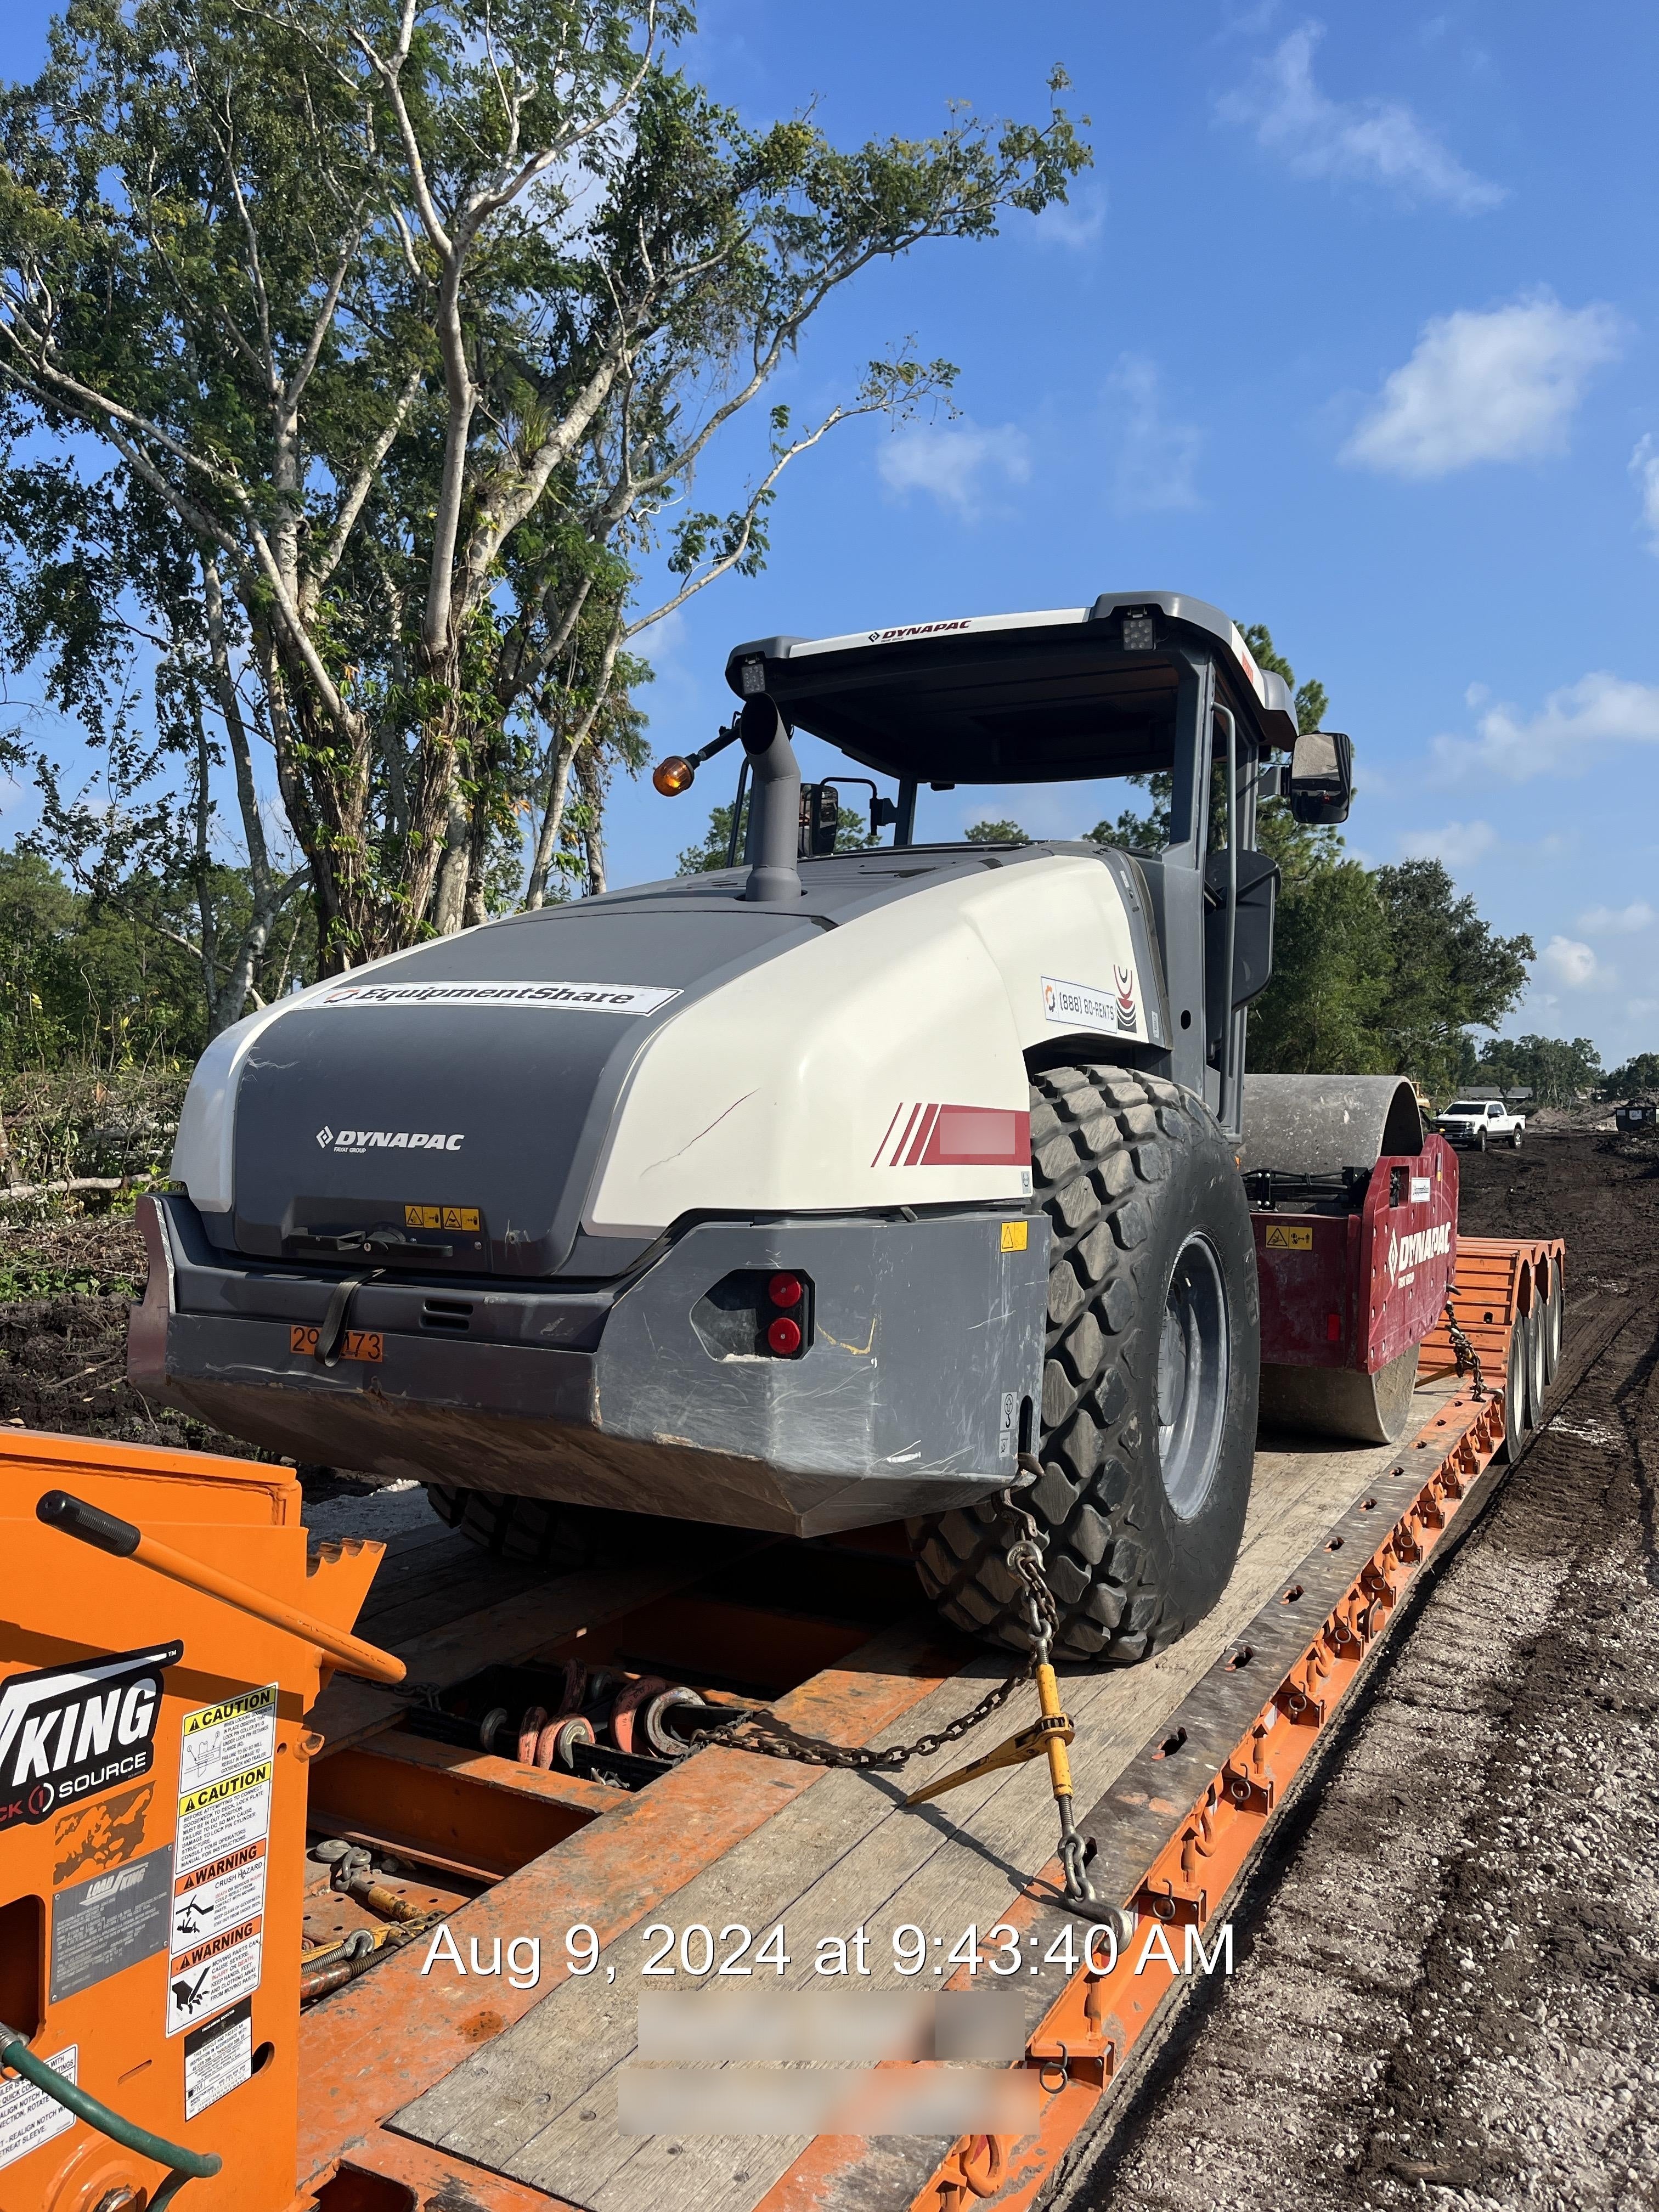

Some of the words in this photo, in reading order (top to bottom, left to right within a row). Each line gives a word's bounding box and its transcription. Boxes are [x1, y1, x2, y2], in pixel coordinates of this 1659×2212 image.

[882, 620, 972, 639] DYNAPAC
[357, 987, 635, 1004] EquipmentShare
[1059, 991, 1082, 1014] (888)
[1084, 998, 1114, 1020] 80-RENTS
[335, 1131, 465, 1150] DYNAPAC
[1398, 1221, 1451, 1272] DYNAPAC
[202, 1689, 270, 1726] CAUTION
[235, 1714, 250, 1723] LOCKING
[251, 1706, 272, 1717] GOOSENECK
[12, 1678, 156, 1787] KING
[228, 1724, 239, 1732] PLACE
[222, 1743, 236, 1753] FLANGE
[222, 1752, 236, 1760] FAILURE
[59, 1752, 146, 1798] SOURCE
[221, 1760, 243, 1773] GOOSENECK
[222, 1758, 235, 1767] RESULT
[198, 1766, 266, 1806] CAUTION
[183, 1810, 202, 1822] BEFORE
[204, 1797, 233, 1814] ATTEMPTING
[240, 1785, 262, 1798] CONNECT
[183, 1812, 213, 1829] GOOSENECK
[236, 1797, 248, 1805] LOCK
[250, 1790, 263, 1800] PLATE
[182, 1830, 201, 1842] FAILURE
[236, 1807, 252, 1818] CAUSE
[182, 1836, 202, 1848] DAMAGE
[211, 1826, 224, 1835] LOCK
[233, 1812, 256, 1825] CYLINDER
[183, 1826, 195, 1835] MUST
[181, 1848, 202, 1861] CONSULT
[204, 1841, 217, 1850] YOUR
[218, 1828, 246, 1844] OPERATORS
[181, 1855, 200, 1867] MANUAL
[195, 1844, 257, 1884] WARNING
[86, 1875, 115, 1899] LOAD
[120, 1867, 146, 1891] KING
[215, 1874, 236, 1889] CRUSH
[238, 1861, 262, 1878] HAZARD
[191, 1922, 252, 1965] WARNING
[212, 1953, 231, 1967] MOVING
[232, 1945, 247, 1956] PARTS
[211, 1968, 228, 1980] INJURY
[211, 1977, 222, 1987] KEEP
[241, 1962, 251, 1971] FEET
[211, 1985, 220, 1994] AND
[221, 1973, 243, 1989] CLOTHING
[244, 1966, 256, 1977] AWAY
[212, 1961, 228, 1973] CAUSE
[210, 1990, 223, 2001] FROM
[224, 1980, 241, 1994] MOVING
[0, 2103, 17, 2119] ALIGN
[20, 2091, 40, 2108] NOTCH
[2, 2089, 20, 2104] QUICK
[27, 2094, 49, 2113] ROTATE
[9, 2121, 35, 2142] REALIGN
[37, 2108, 56, 2126] NOTCH
